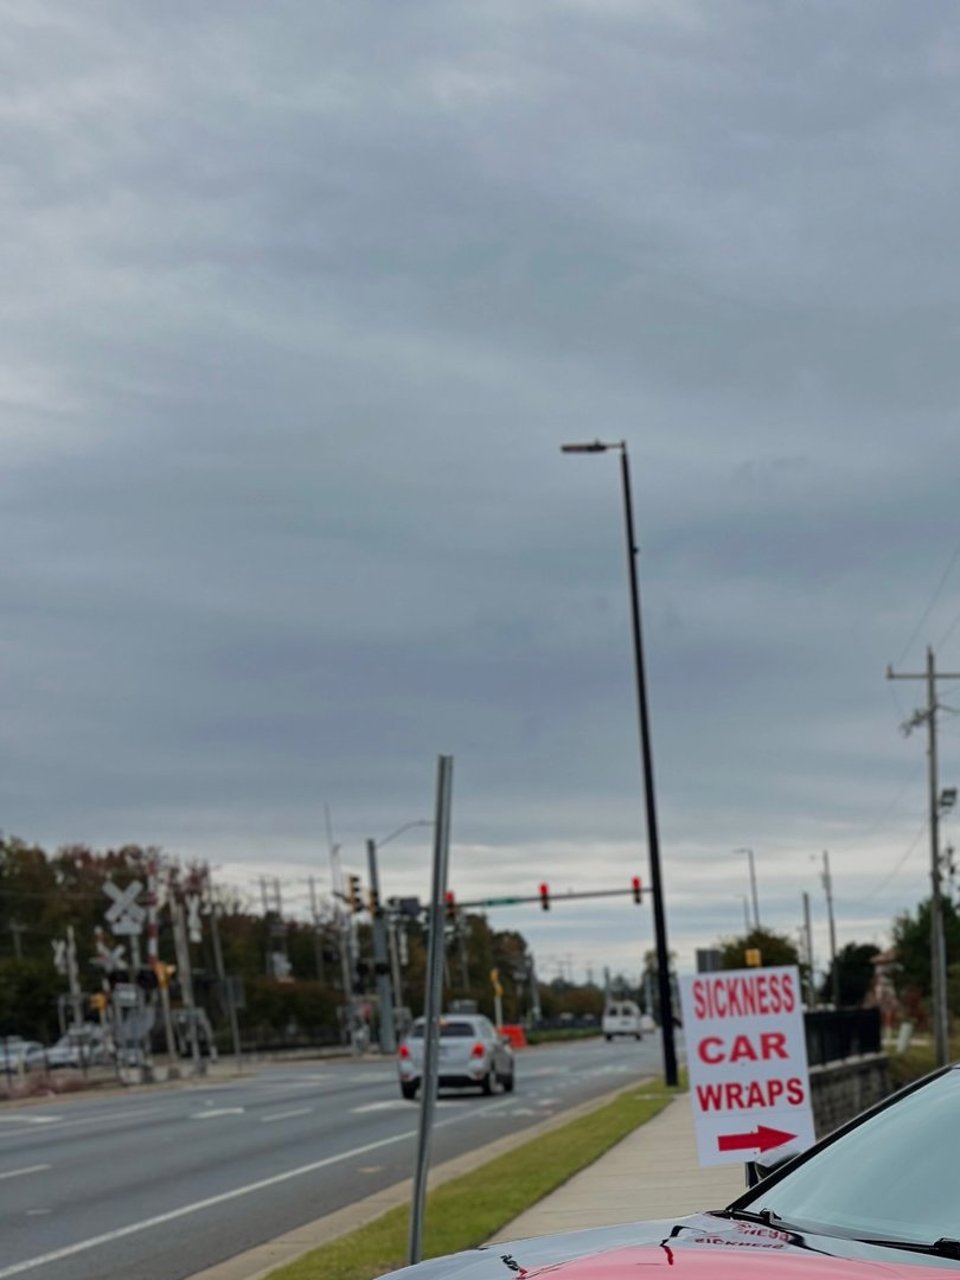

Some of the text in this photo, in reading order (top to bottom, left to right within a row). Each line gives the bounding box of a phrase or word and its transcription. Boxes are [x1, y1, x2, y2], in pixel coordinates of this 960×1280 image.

[692, 974, 796, 1020] SICKNESS
[697, 1032, 790, 1065] CAR
[696, 1077, 805, 1112] WRAPS
